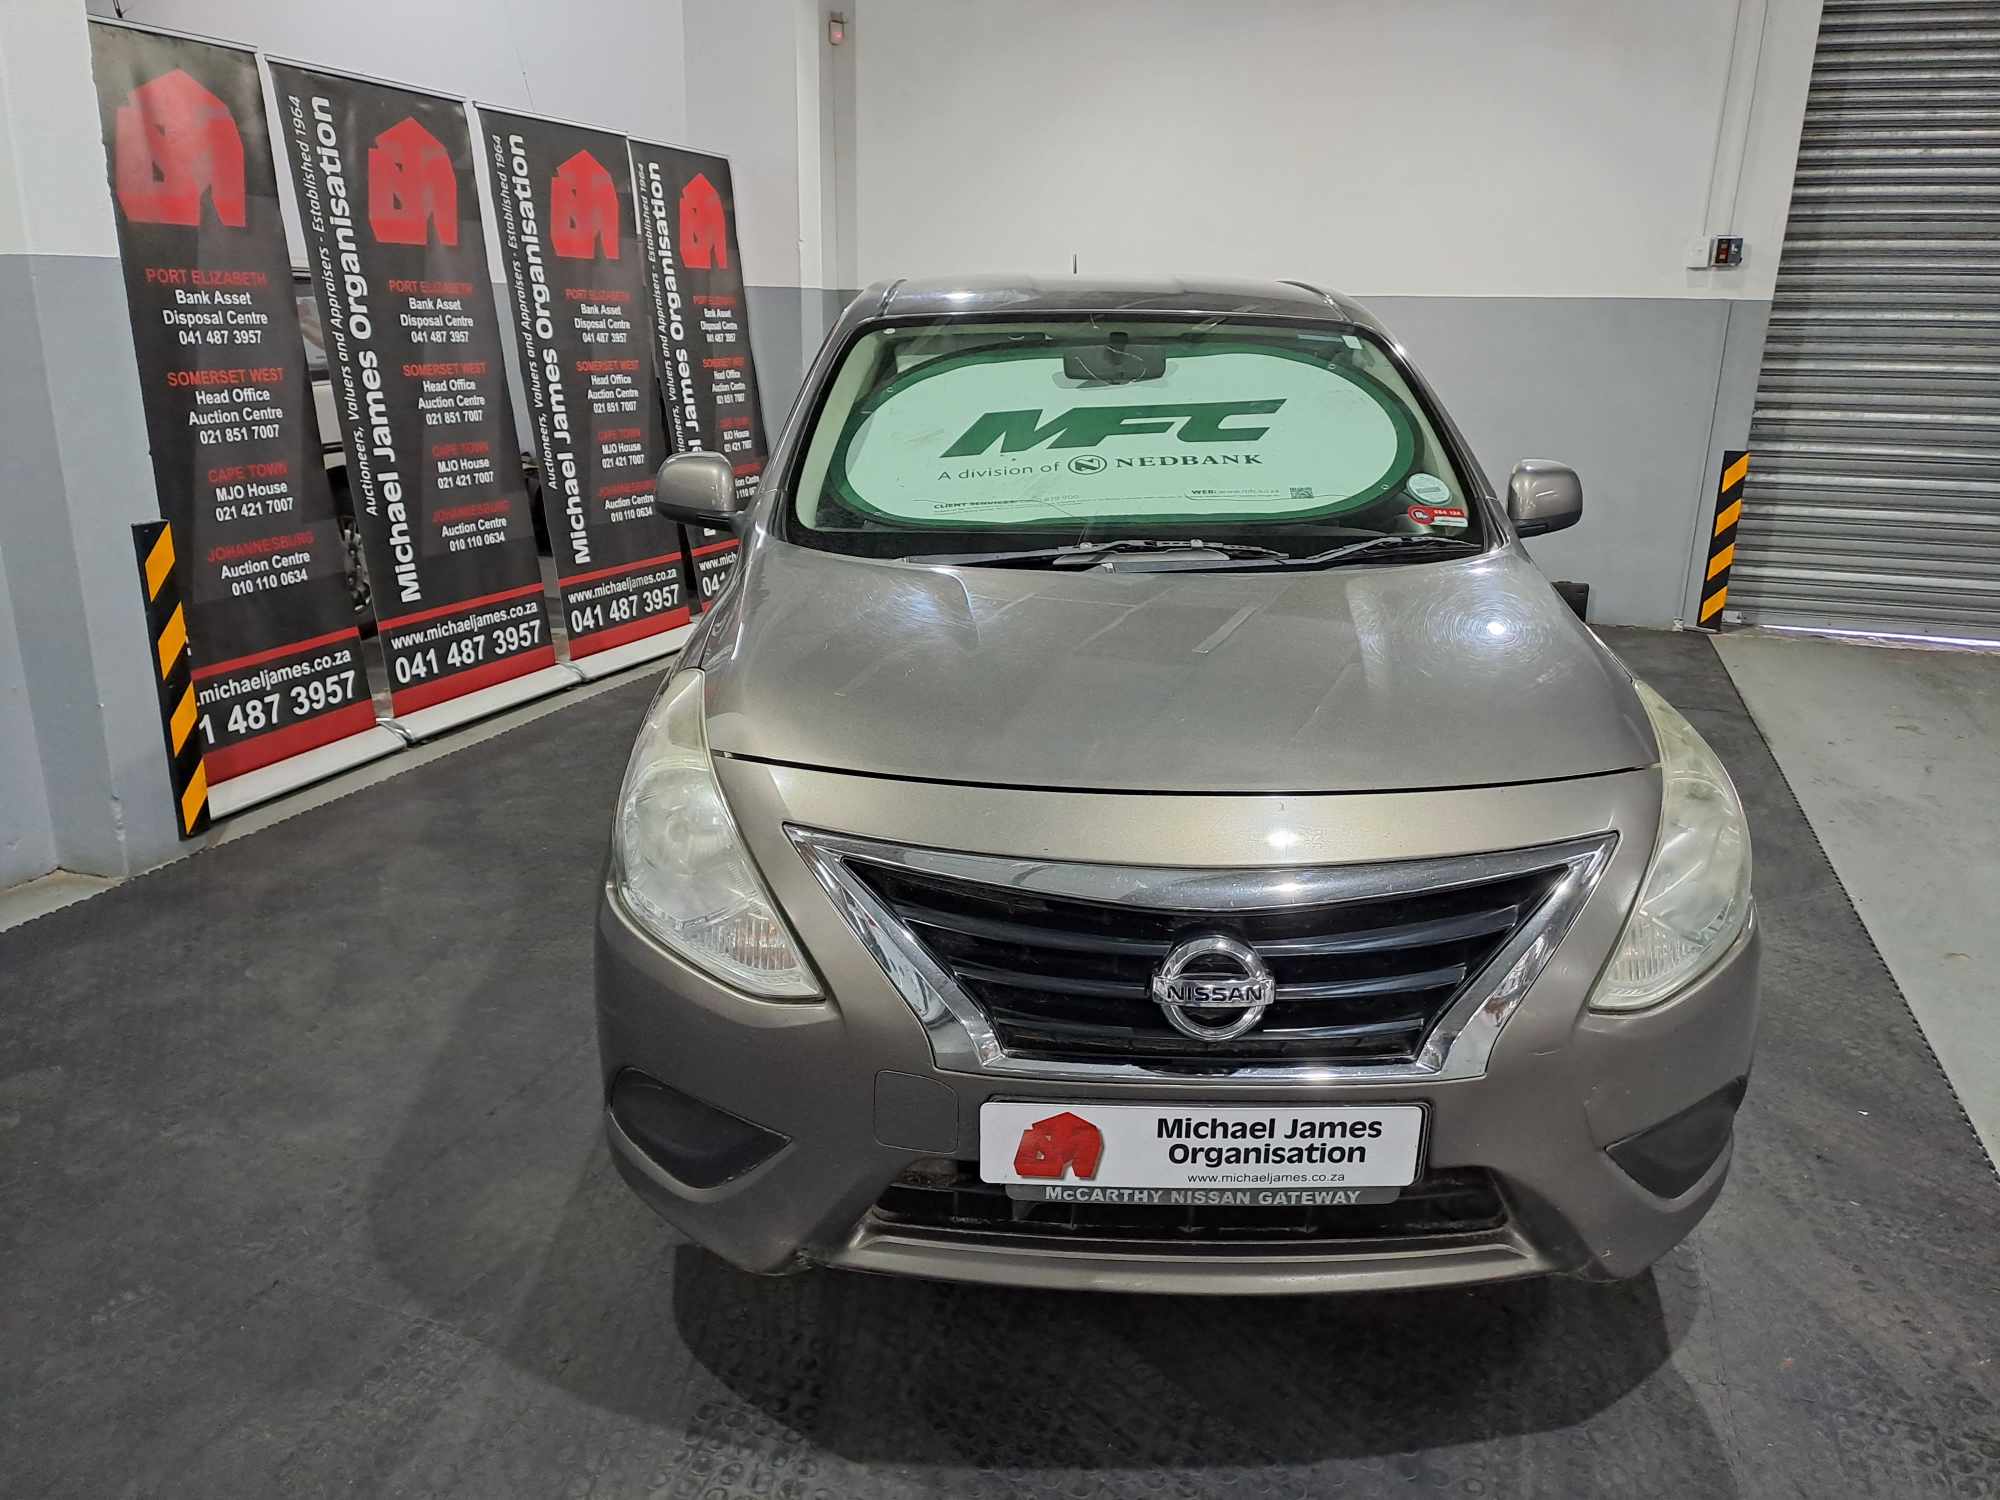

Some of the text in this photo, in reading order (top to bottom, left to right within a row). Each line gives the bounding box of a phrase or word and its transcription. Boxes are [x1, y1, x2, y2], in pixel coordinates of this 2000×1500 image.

[288, 95, 307, 136] 1964
[492, 134, 506, 168] 1964
[295, 140, 326, 233] Established
[495, 171, 518, 249] Established
[648, 162, 684, 341] Organisation
[145, 268, 186, 283] PORT
[175, 289, 252, 305] Bank Asset
[318, 246, 343, 330] Appraisers
[511, 260, 533, 330] Appraisers
[408, 297, 462, 311] Bank Asset
[580, 304, 599, 314] Bank
[163, 310, 268, 327] Disposal Centre
[400, 314, 474, 329] Disposal Centre
[179, 330, 262, 345] 041 487 3957
[332, 331, 349, 362] and
[411, 331, 469, 343] 041 487 3957
[522, 332, 536, 358] and
[311, 96, 422, 603] Michael James Organisation
[508, 134, 592, 564] Michael James Organisation
[167, 368, 285, 387] SOMERSET WEST
[422, 379, 476, 393] Head Office
[528, 361, 544, 408] Valuers
[195, 388, 270, 404] Head Office
[339, 365, 360, 421] Valuers
[588, 388, 614, 400] Auction
[676, 348, 699, 432] James
[418, 394, 486, 410] Auction Centre
[188, 407, 283, 425] Auction Centre
[426, 409, 483, 425] 021 851 7007
[200, 424, 280, 445] 021 851 7007
[939, 398, 1288, 458] MFC
[538, 413, 558, 490] Auctioneers,
[618, 442, 641, 452] House
[353, 427, 378, 516] Auctioneers,
[437, 458, 490, 473] MJO House
[937, 471, 952, 481] A
[958, 466, 1033, 479] division
[1040, 461, 1062, 473] of
[1117, 454, 1264, 468] NEDBANK
[216, 482, 288, 502] MJO House
[437, 471, 494, 490] 021 421 7007
[216, 497, 294, 522] 021 421 7007
[605, 494, 654, 510] Auction Centre
[441, 517, 507, 538] Auction Centre
[449, 531, 506, 552] 010 110 0634
[221, 551, 311, 580] Auction Centre
[231, 568, 309, 596] 010 110 0634
[567, 568, 677, 604] www.michaeljames.co.za
[571, 583, 680, 633] 041 487 3957
[391, 601, 538, 651] www.michaeljames.co.za
[395, 619, 541, 684] 041 487 3957
[227, 693, 280, 735] 487
[290, 670, 356, 715] 3957
[1167, 986, 1262, 1001] NISSAN
[1156, 1117, 1383, 1139] Michael James
[1168, 1142, 1367, 1168] Organisation
[1187, 1172, 1345, 1185] www.michaeljames.co.za
[1045, 1186, 1361, 1206] McCARTHY NISSAN GATEWAY
